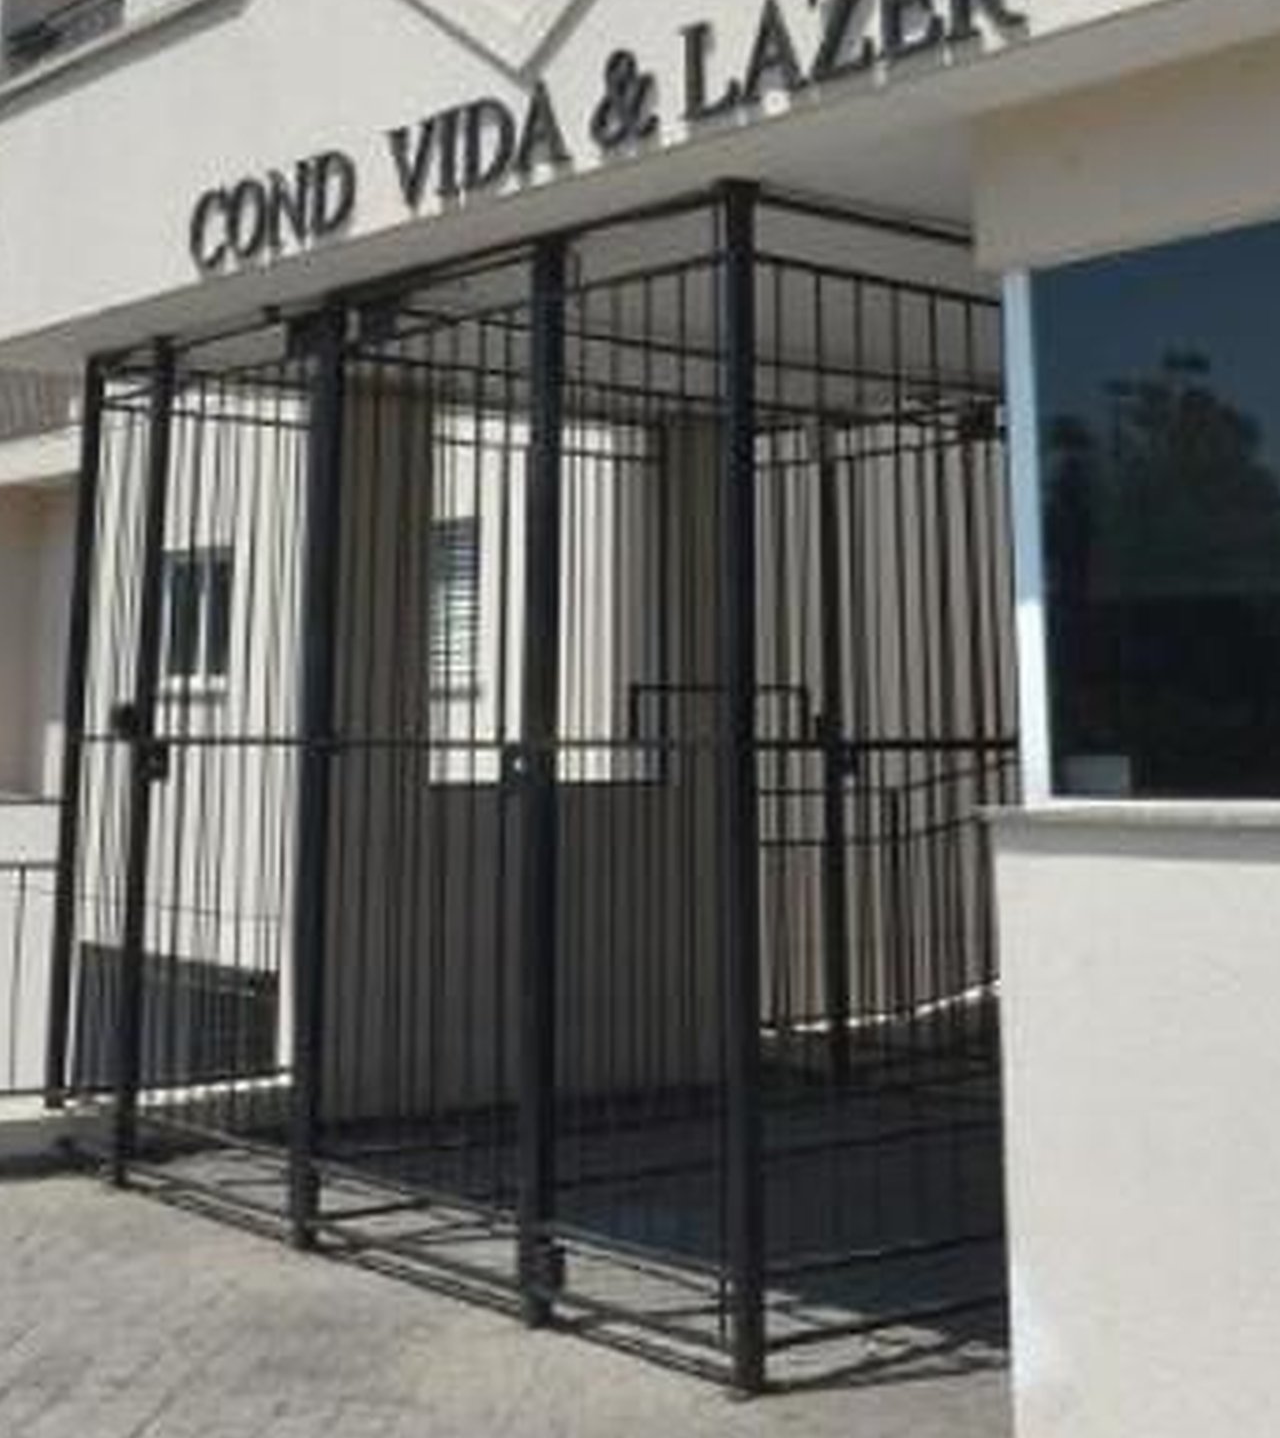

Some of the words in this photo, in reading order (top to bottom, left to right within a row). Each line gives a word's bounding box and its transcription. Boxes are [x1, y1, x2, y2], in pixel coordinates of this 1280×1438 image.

[190, 151, 355, 269] COND
[388, 80, 570, 209] VIDA
[589, 48, 660, 150] &
